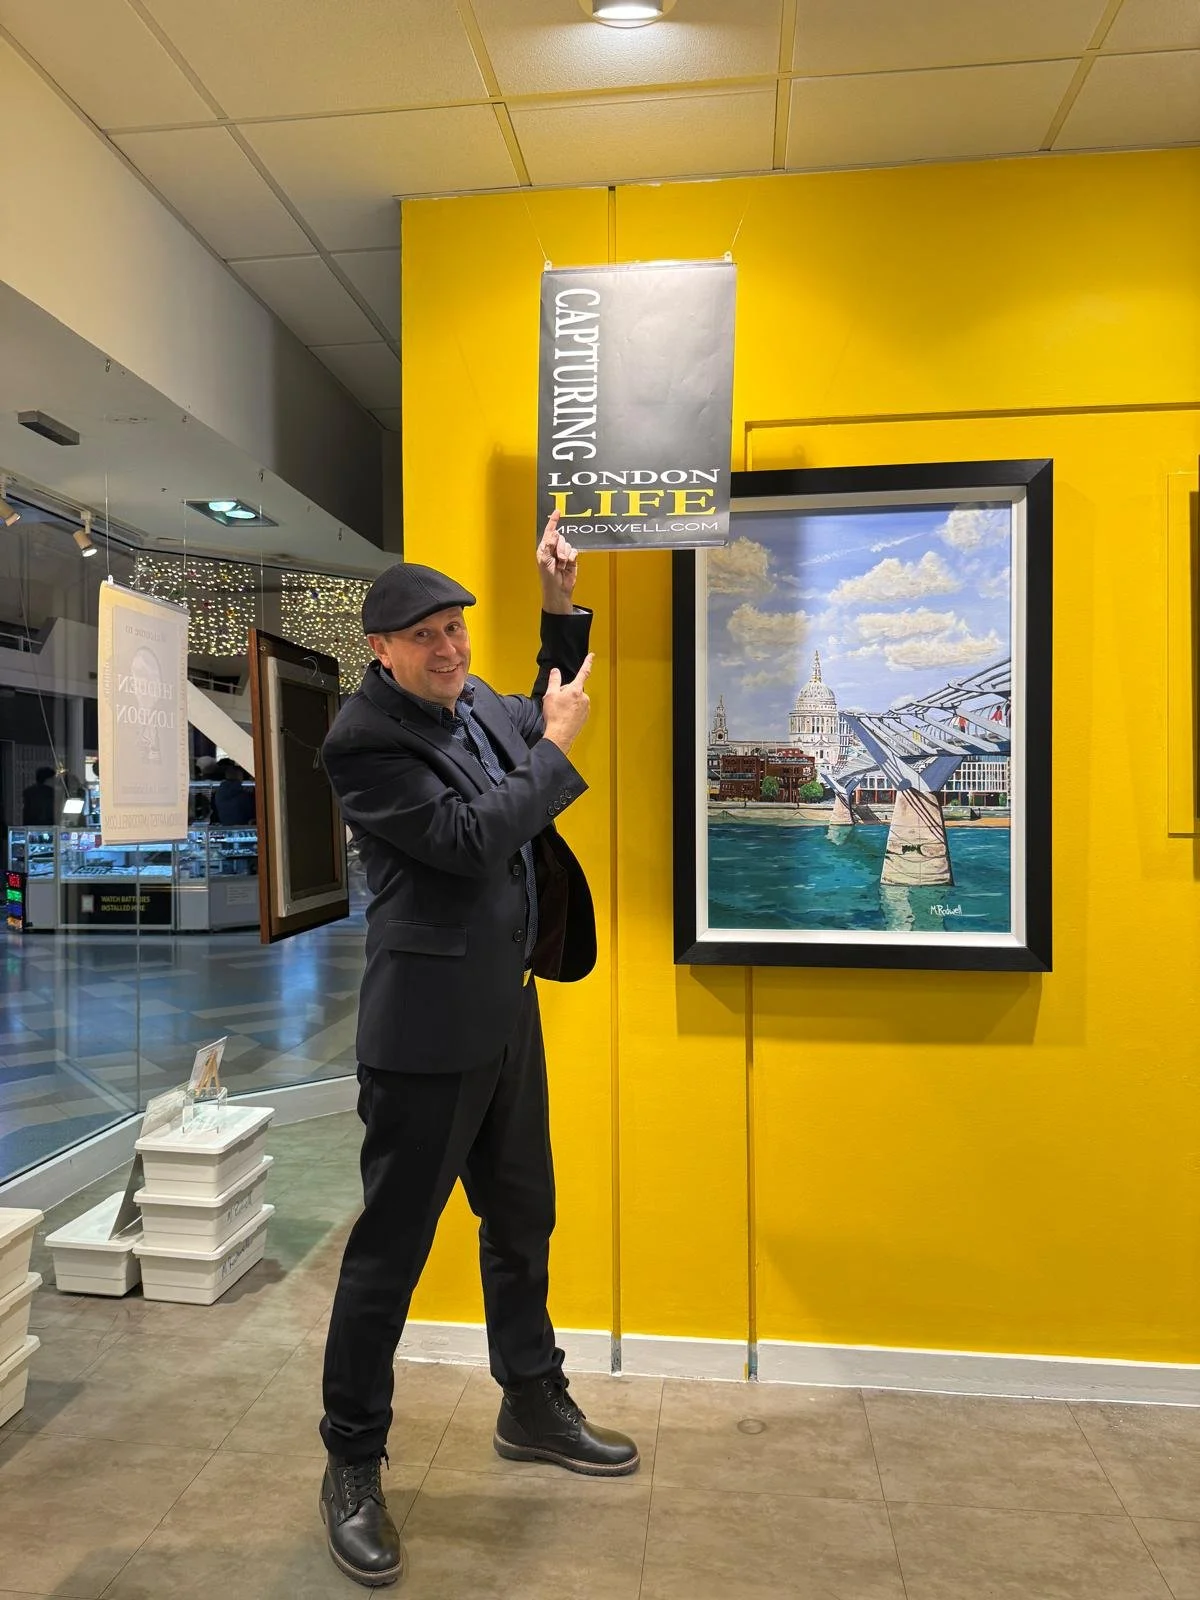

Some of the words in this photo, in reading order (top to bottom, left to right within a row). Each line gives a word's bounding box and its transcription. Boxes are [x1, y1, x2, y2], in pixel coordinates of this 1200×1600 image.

[552, 288, 600, 462] CAPTURING
[547, 469, 720, 487] LONDON
[547, 488, 717, 518] LIFE
[100, 895, 120, 903] WATCH
[101, 904, 131, 912] INSTALLED
